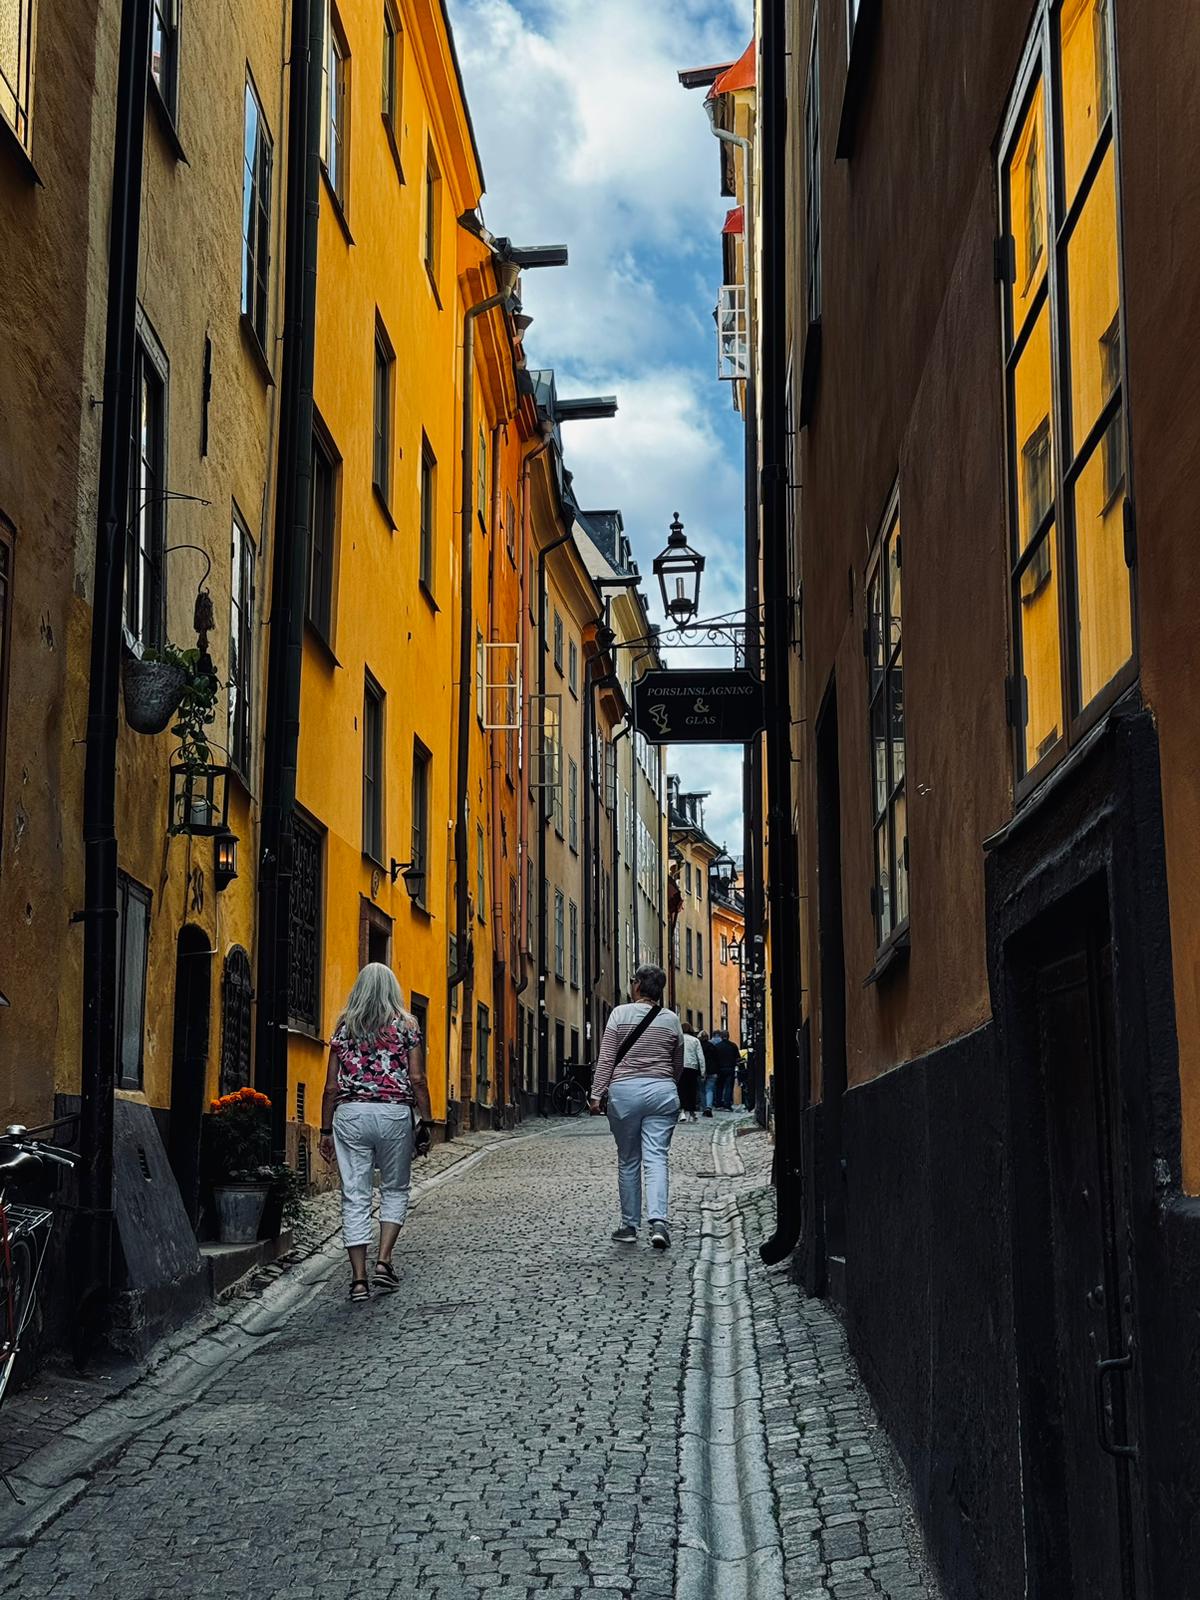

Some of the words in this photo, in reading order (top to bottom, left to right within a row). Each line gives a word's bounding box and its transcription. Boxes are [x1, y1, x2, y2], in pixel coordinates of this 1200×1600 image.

[647, 686, 753, 696] PORSLINSLAGNING
[693, 697, 710, 713] &
[685, 716, 716, 725] GLAS
